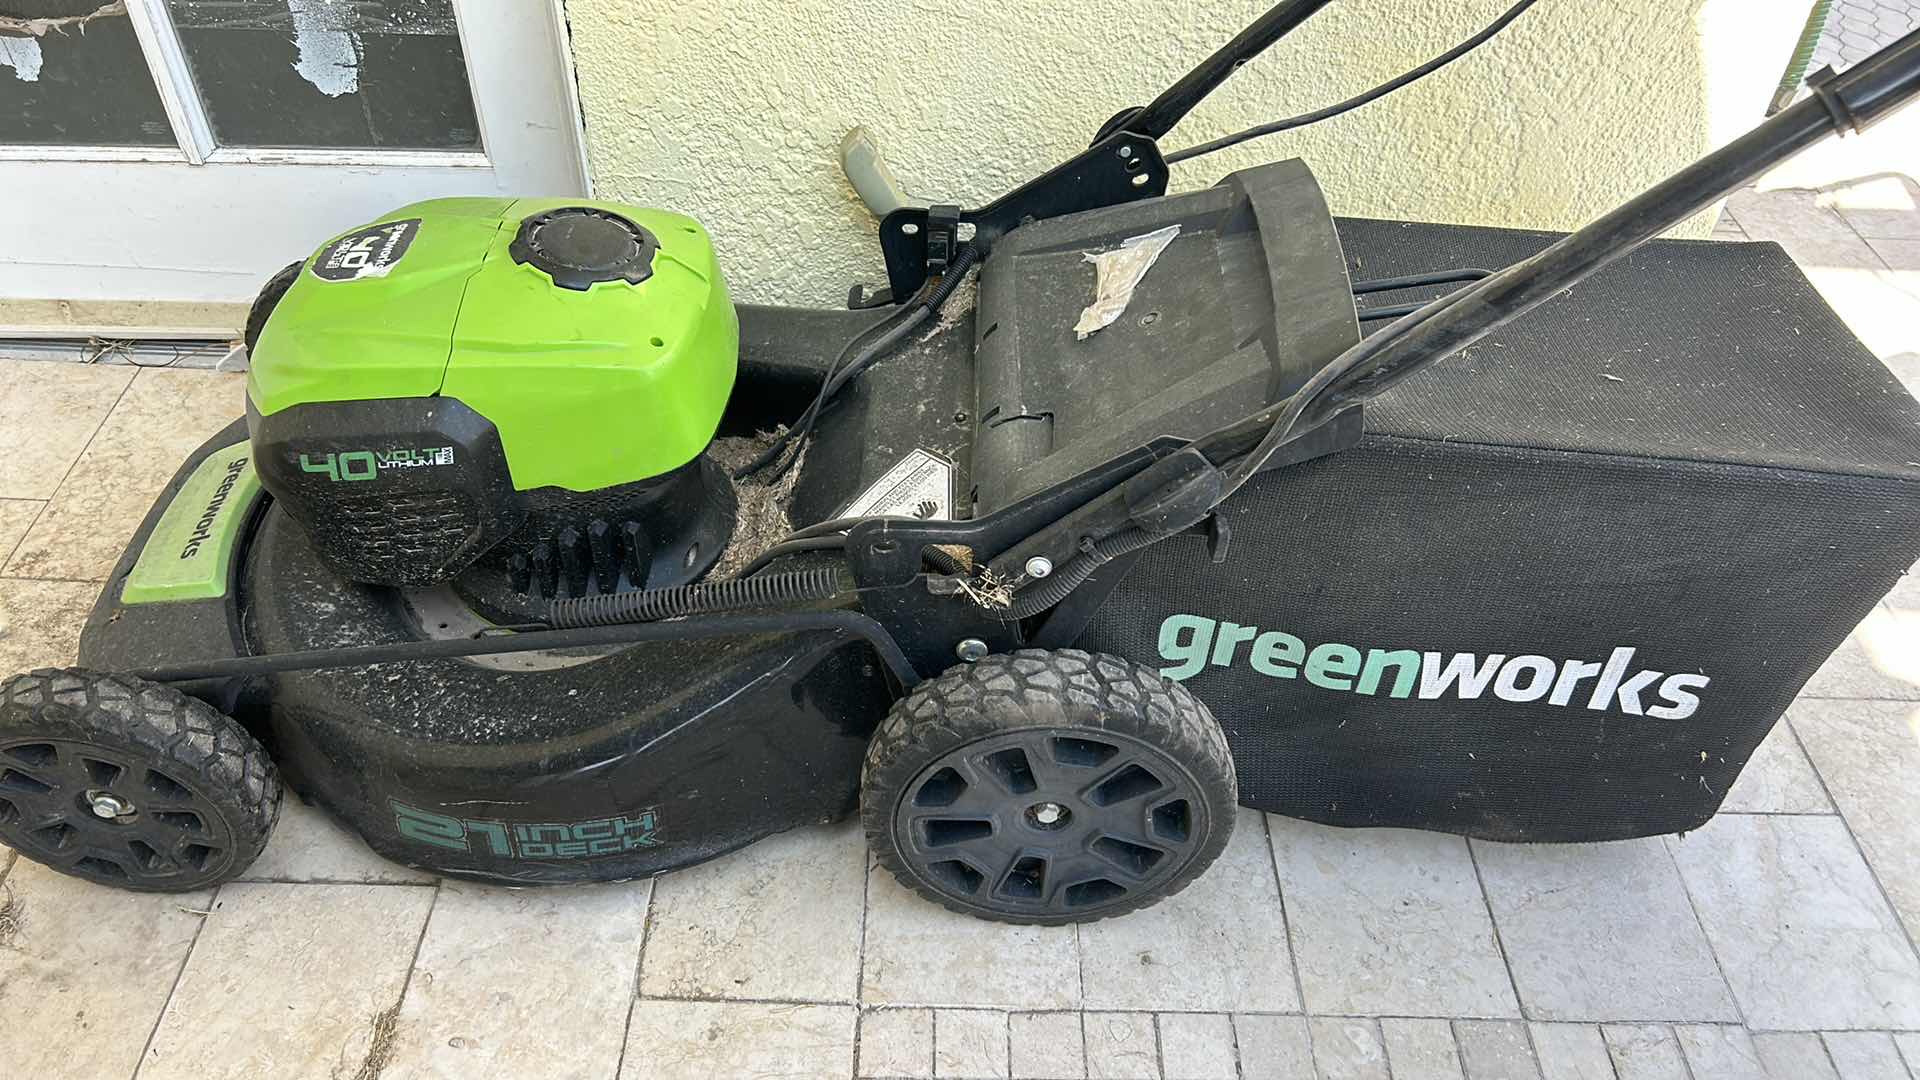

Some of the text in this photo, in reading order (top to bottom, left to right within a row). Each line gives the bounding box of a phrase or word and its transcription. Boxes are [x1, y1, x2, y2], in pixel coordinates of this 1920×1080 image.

[341, 236, 381, 269] 40
[300, 447, 440, 481] 40 VOLT
[378, 459, 434, 469] LITHIUM
[180, 457, 248, 560] greenworks
[1158, 613, 1711, 720] greenworks
[388, 798, 656, 858] 21 INCH
[520, 830, 658, 858] DECK
